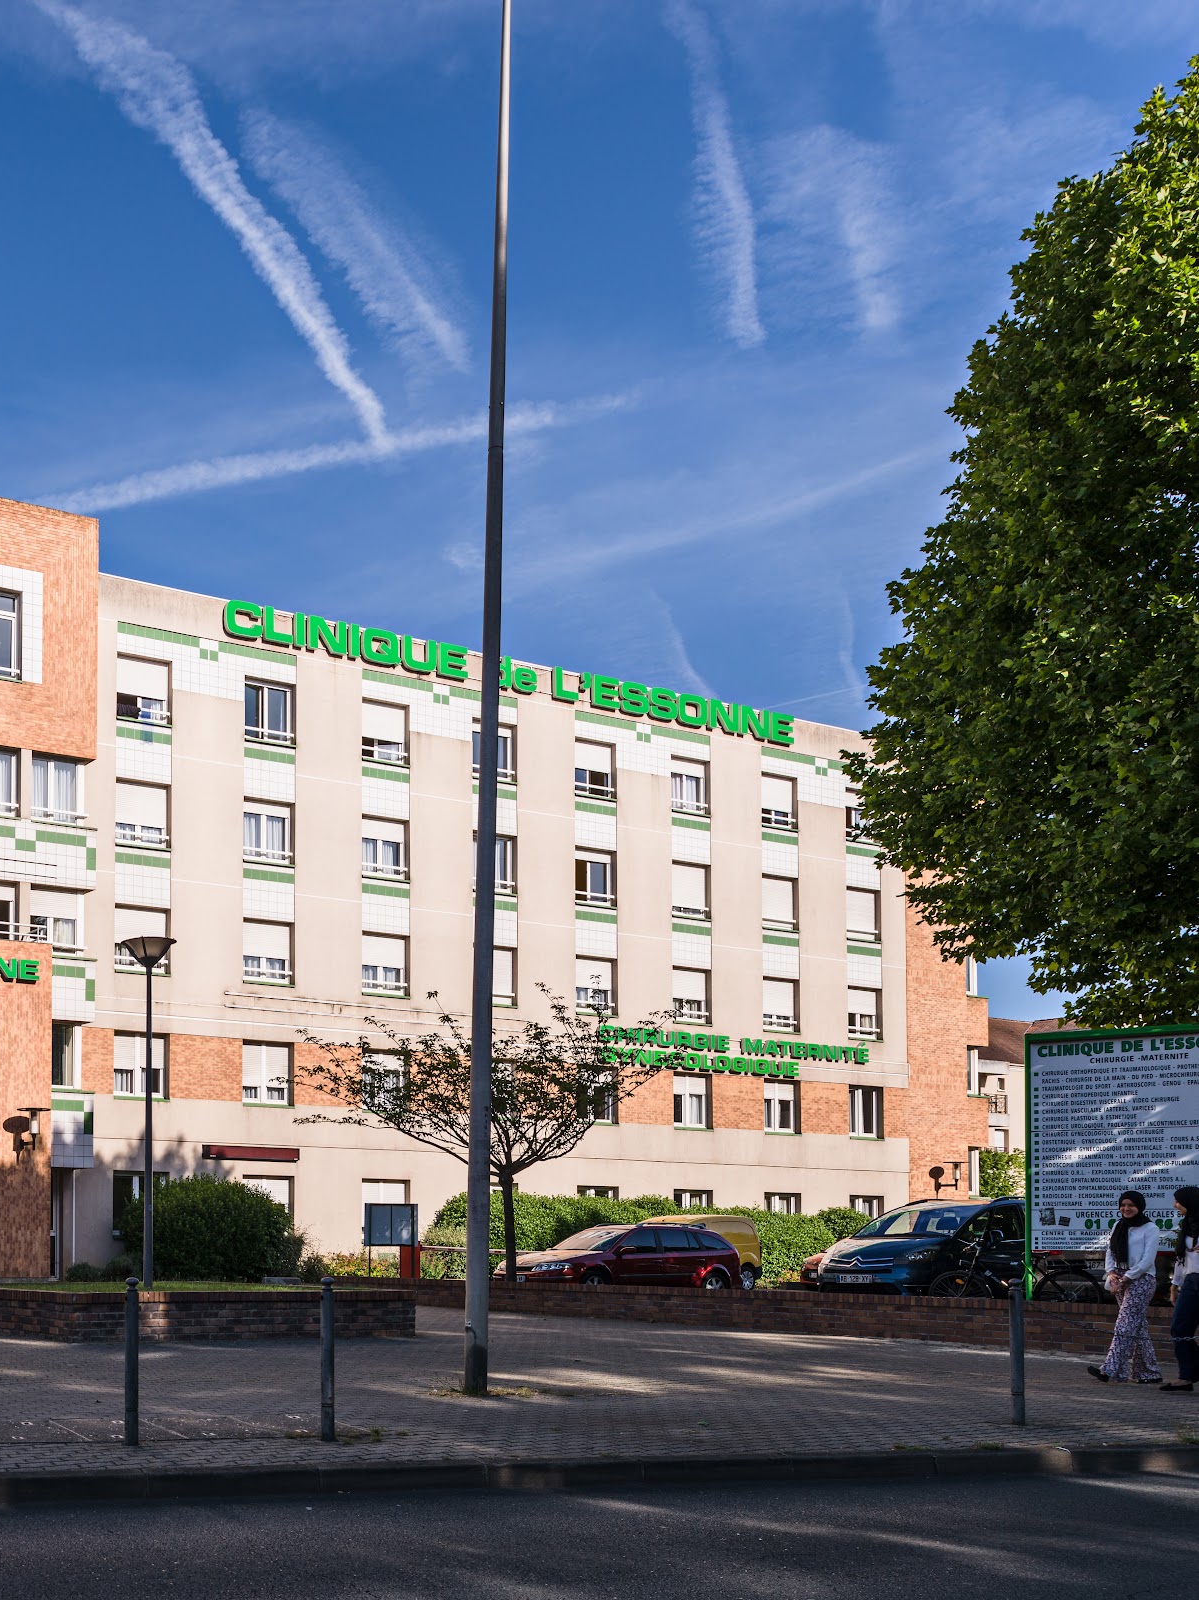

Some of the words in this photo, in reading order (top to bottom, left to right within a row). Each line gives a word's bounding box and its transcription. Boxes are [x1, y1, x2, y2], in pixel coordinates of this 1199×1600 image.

[223, 599, 468, 681] CLINIQUE
[499, 656, 538, 692] de
[554, 666, 796, 746] L'ESSONNE
[1038, 1042, 1114, 1058] CLINIQUE
[1121, 1040, 1144, 1052] DE
[1150, 1036, 1199, 1052] L'ESS
[1090, 1056, 1134, 1064] CHIRURGIE
[1084, 1218, 1100, 1229] 01
